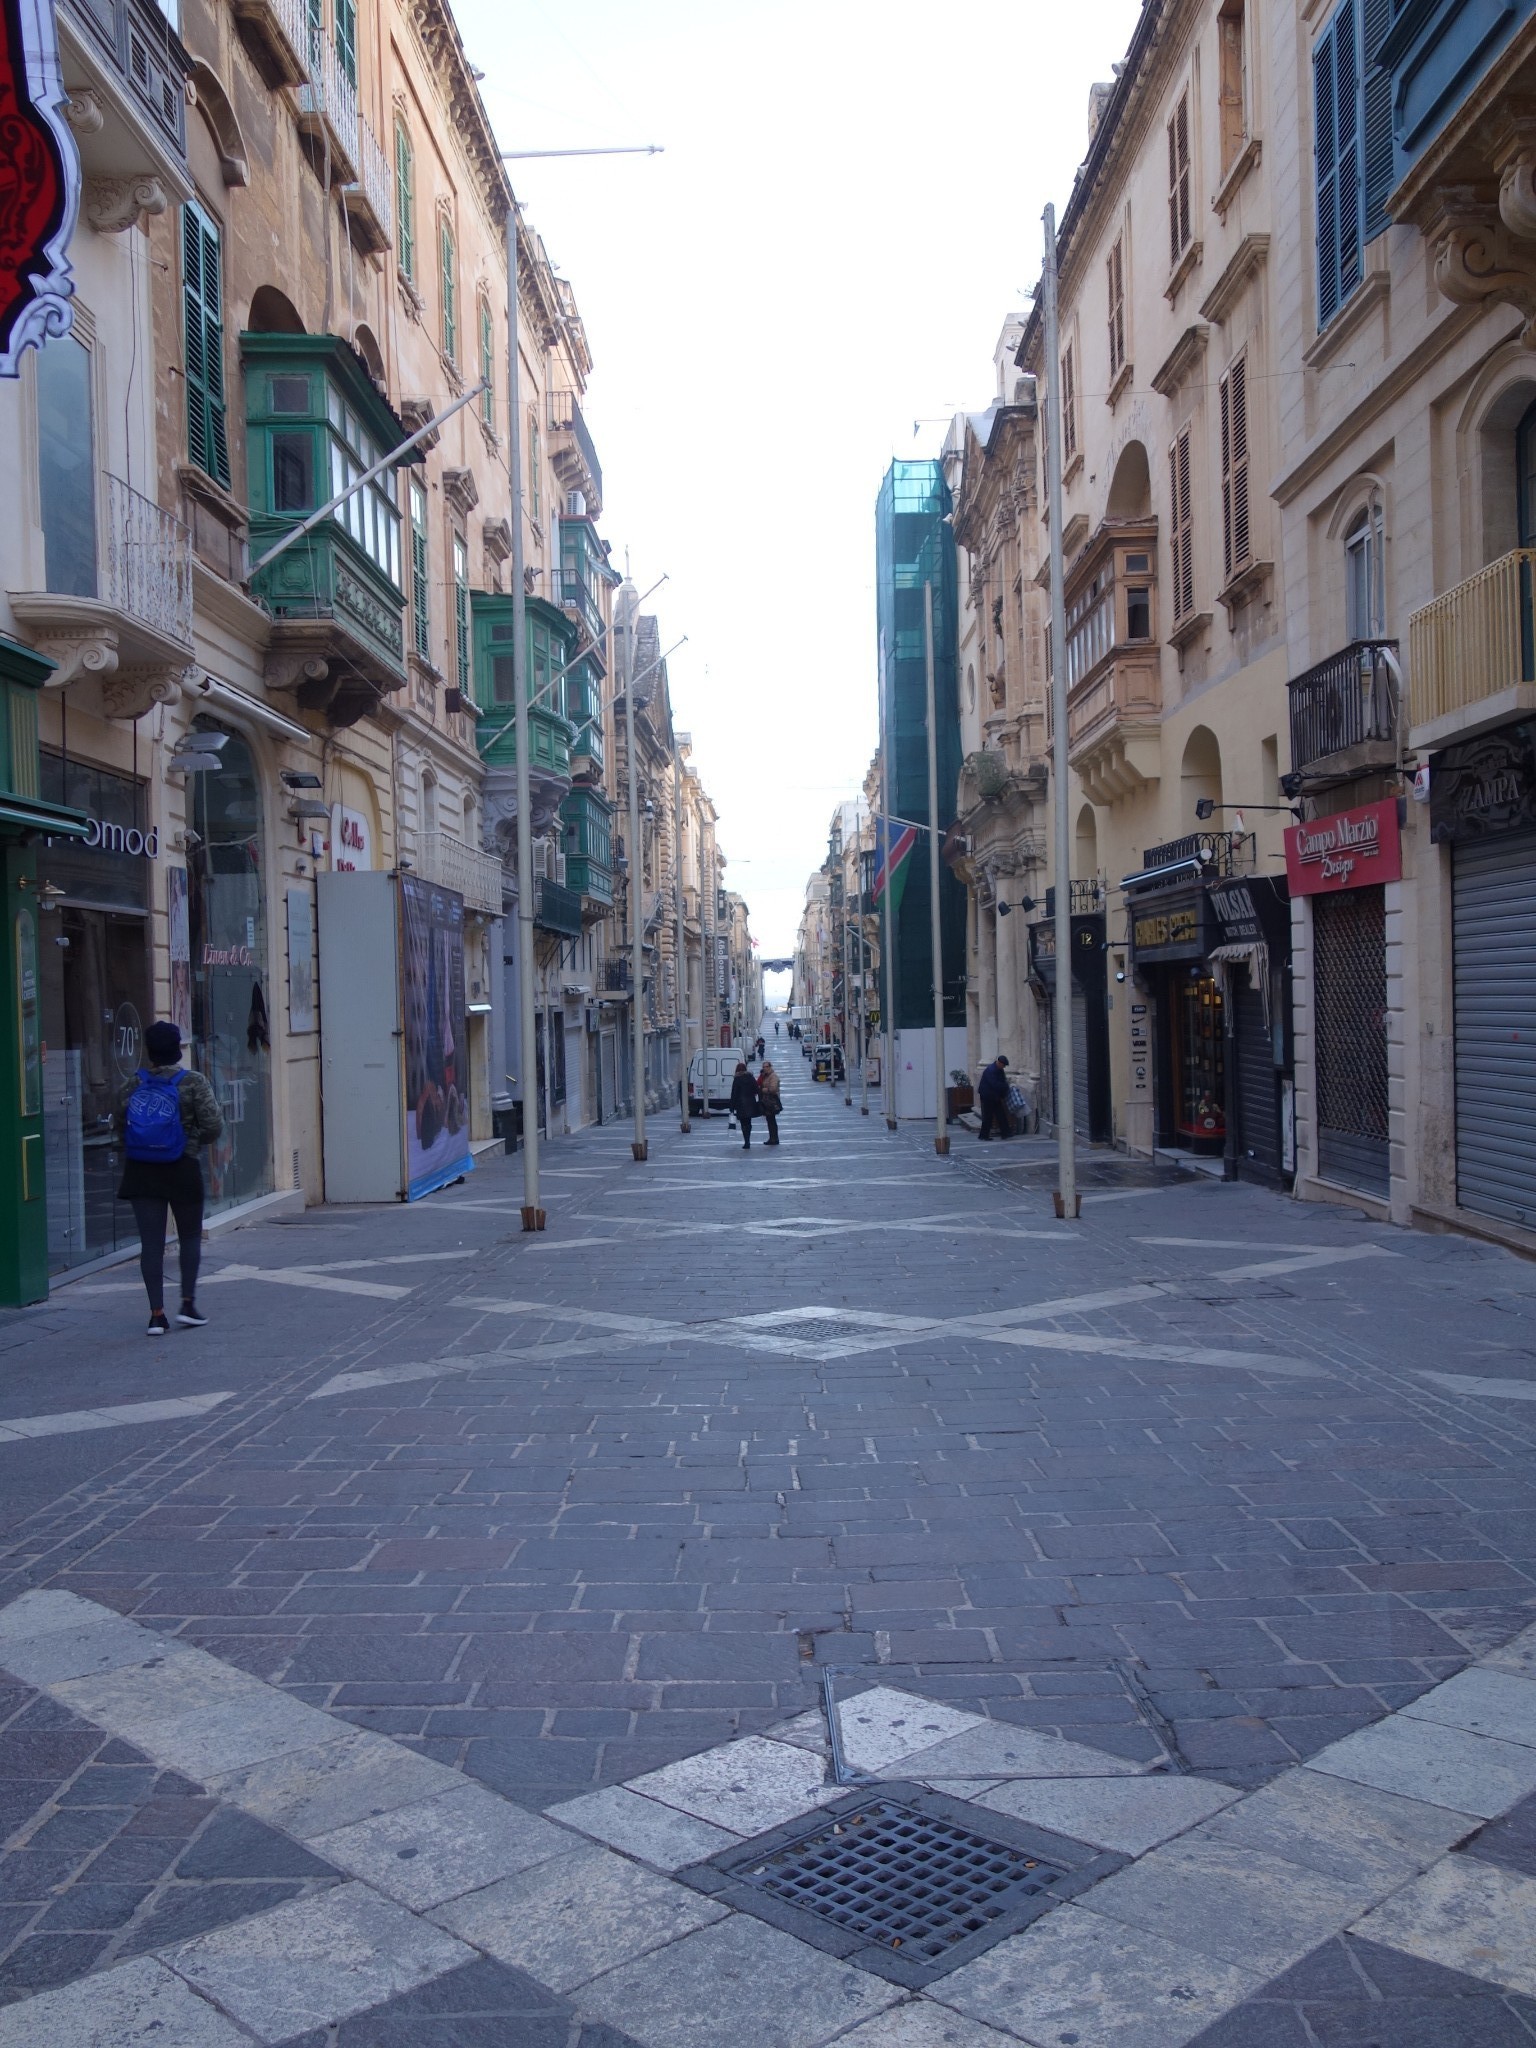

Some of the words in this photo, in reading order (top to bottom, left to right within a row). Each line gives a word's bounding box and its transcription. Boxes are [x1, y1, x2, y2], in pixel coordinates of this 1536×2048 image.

[1462, 774, 1519, 811] ZAMPA
[1296, 829, 1335, 858] Campo
[1336, 815, 1377, 846] Marzio
[1321, 856, 1354, 883] Design
[1210, 887, 1256, 922] PULSAR
[1081, 932, 1092, 945] 12
[718, 939, 726, 995] Archaeology
